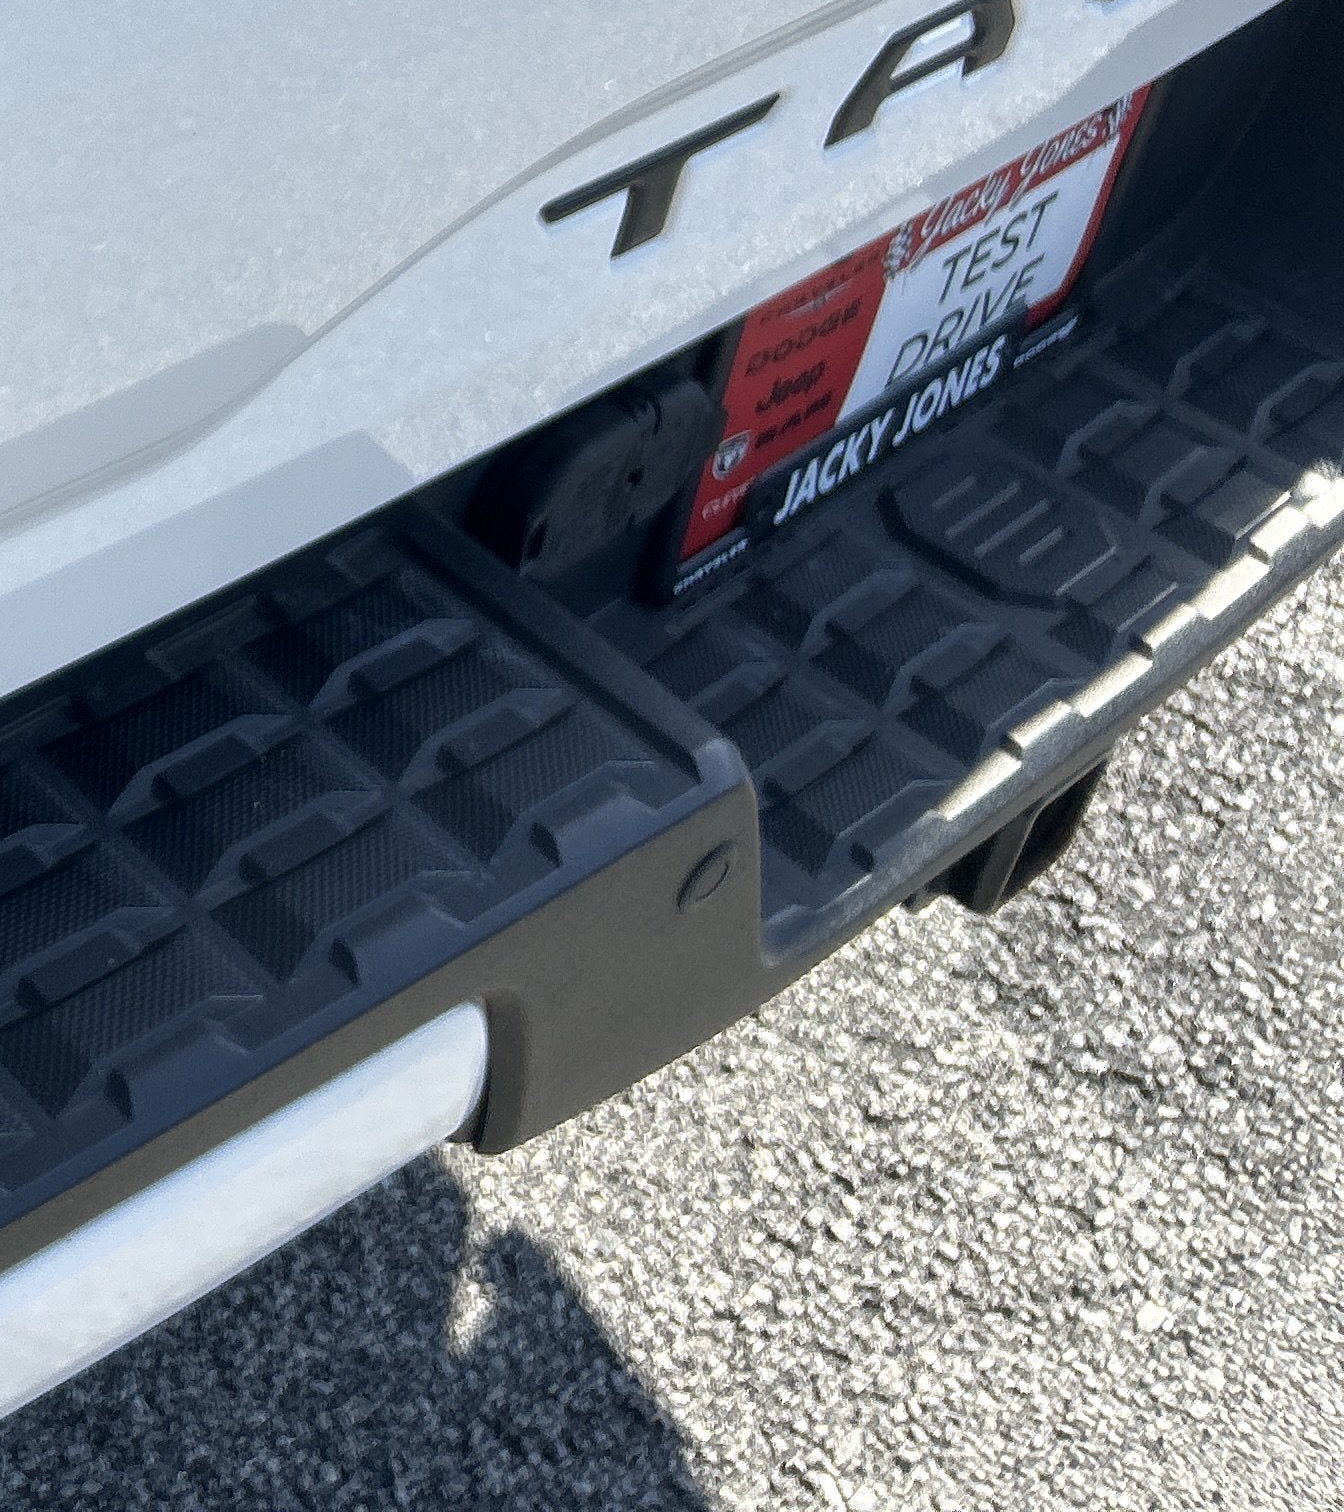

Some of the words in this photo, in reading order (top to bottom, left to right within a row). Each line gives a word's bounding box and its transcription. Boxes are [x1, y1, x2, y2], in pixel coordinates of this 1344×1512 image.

[938, 190, 1060, 305] TEST
[744, 298, 861, 377] DODGE
[885, 253, 1045, 388] DRIVE
[772, 406, 897, 527] JACKY
[892, 334, 1007, 447] JONES
